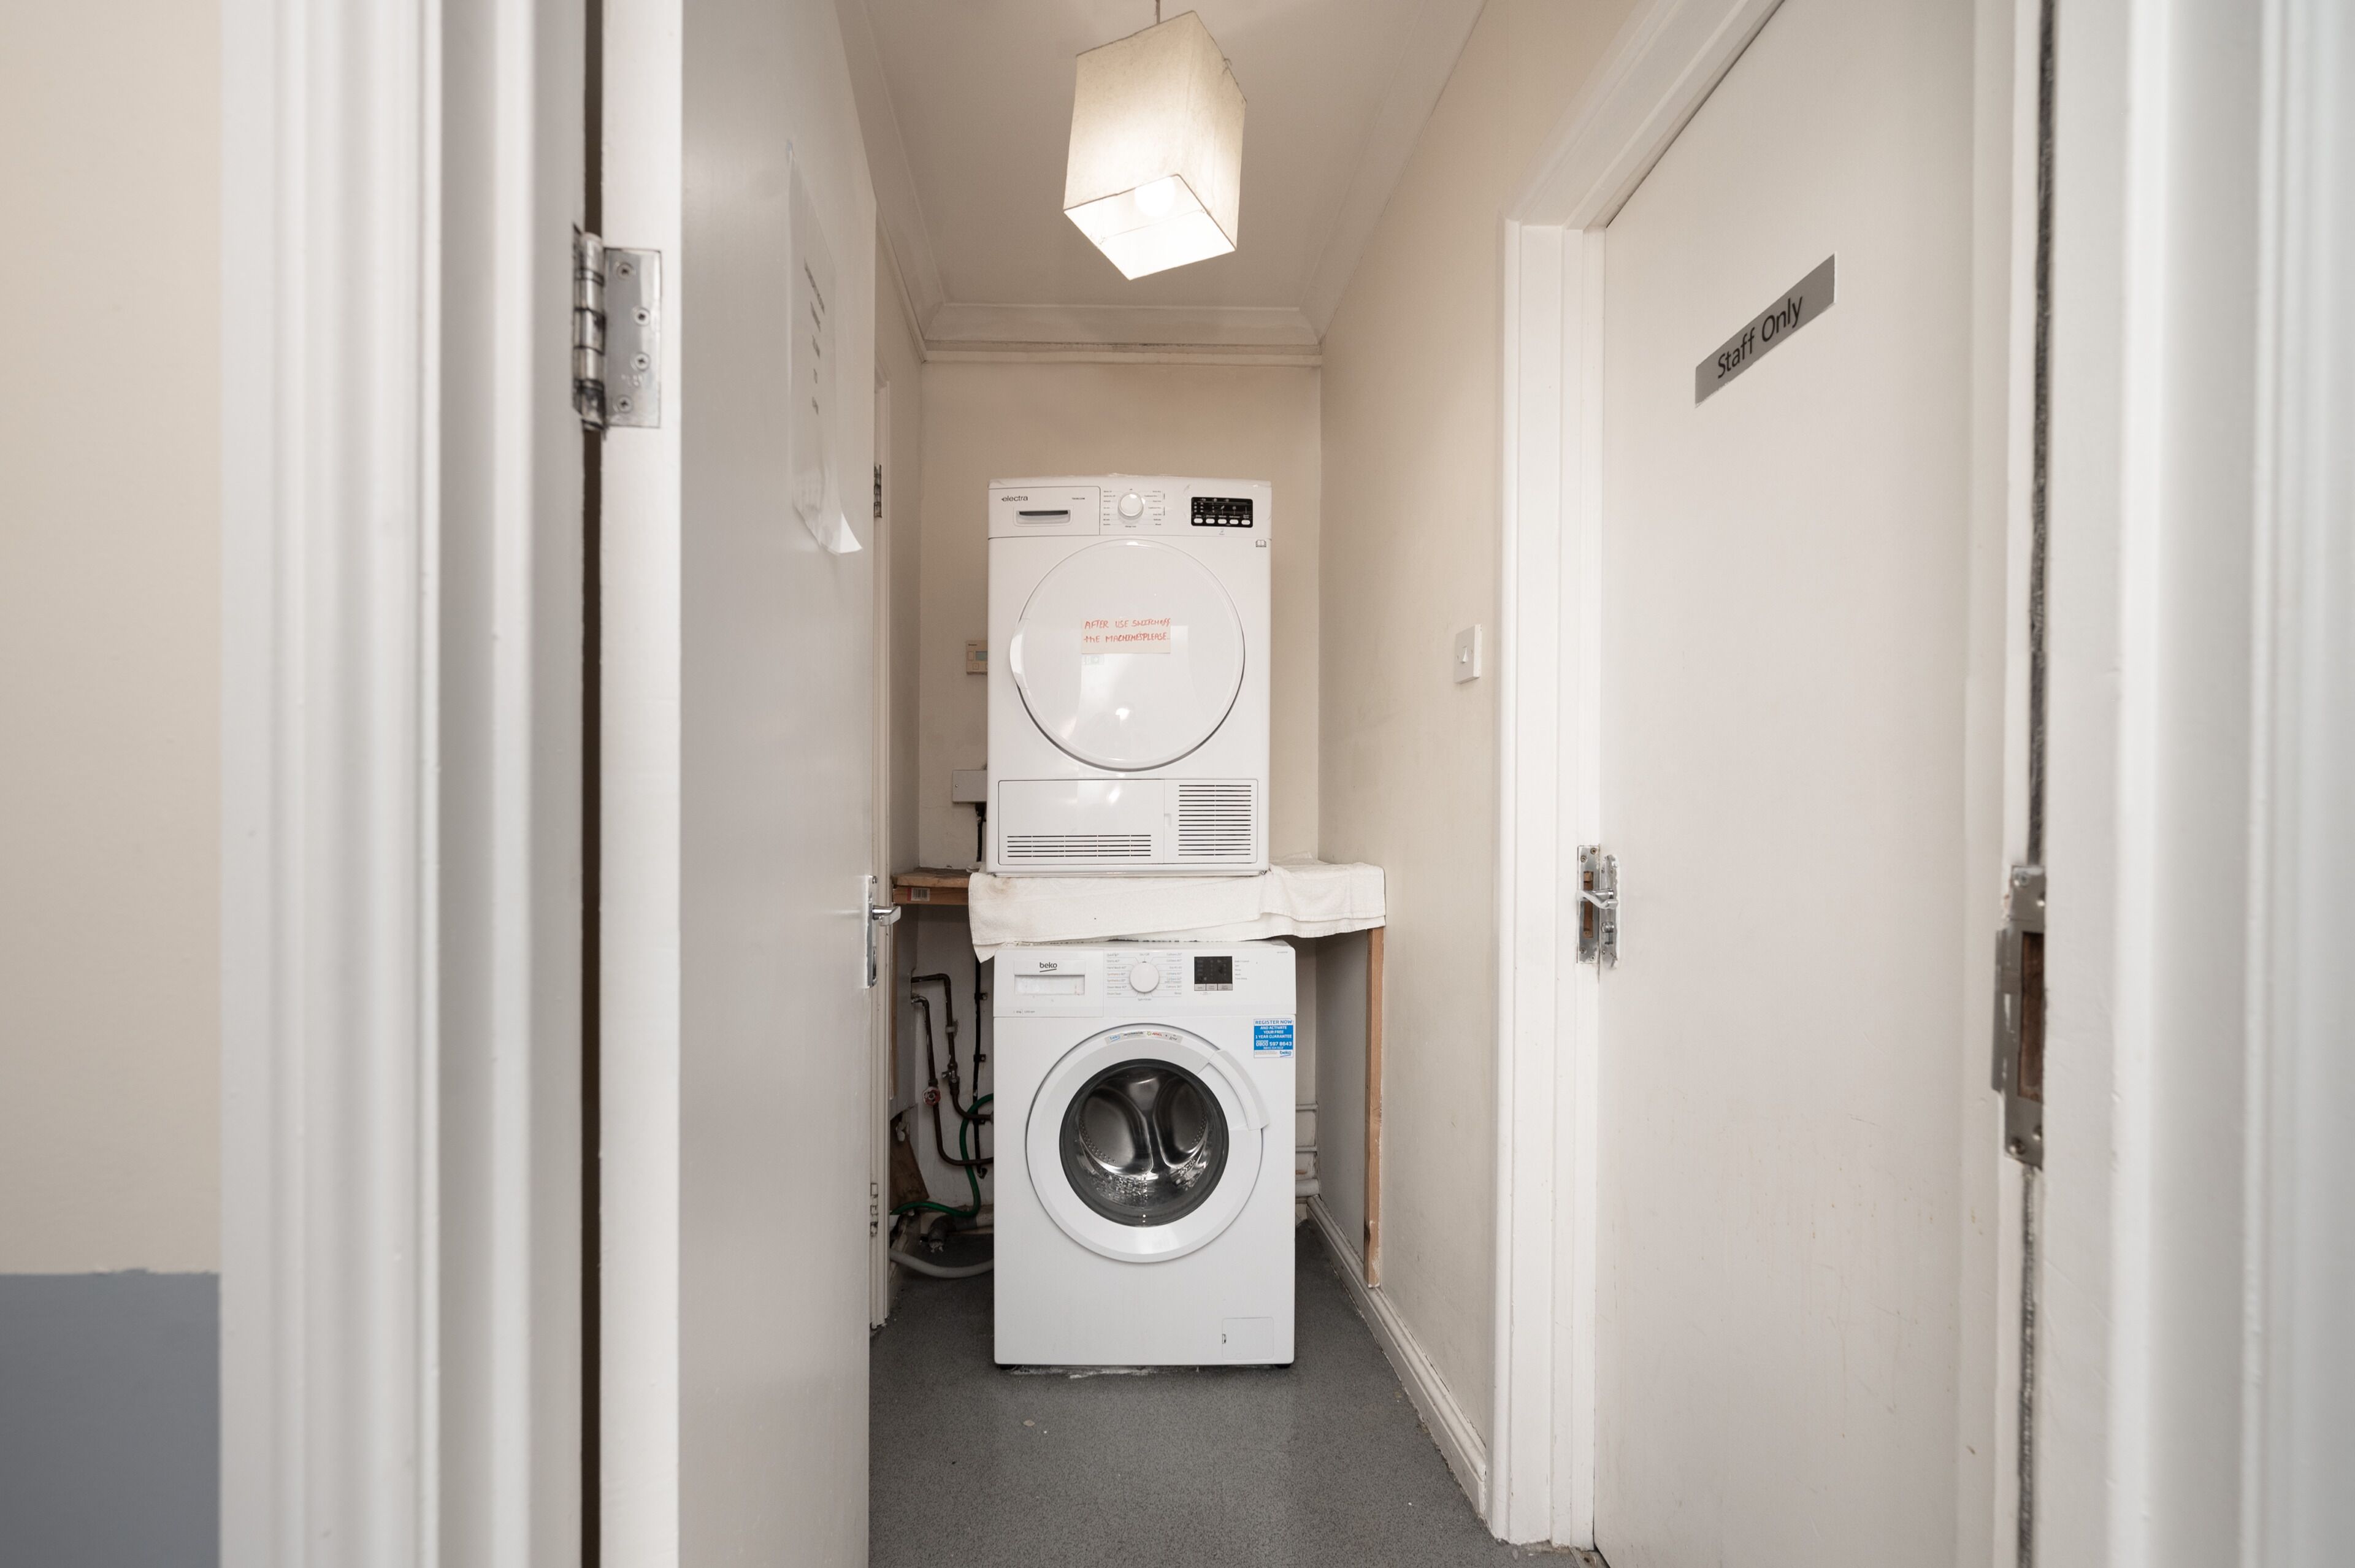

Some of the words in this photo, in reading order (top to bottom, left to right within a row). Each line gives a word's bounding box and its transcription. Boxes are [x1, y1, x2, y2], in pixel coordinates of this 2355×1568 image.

[1718, 326, 1755, 378] Staff
[1761, 296, 1803, 342] Only
[1084, 619, 1109, 629] AFTER
